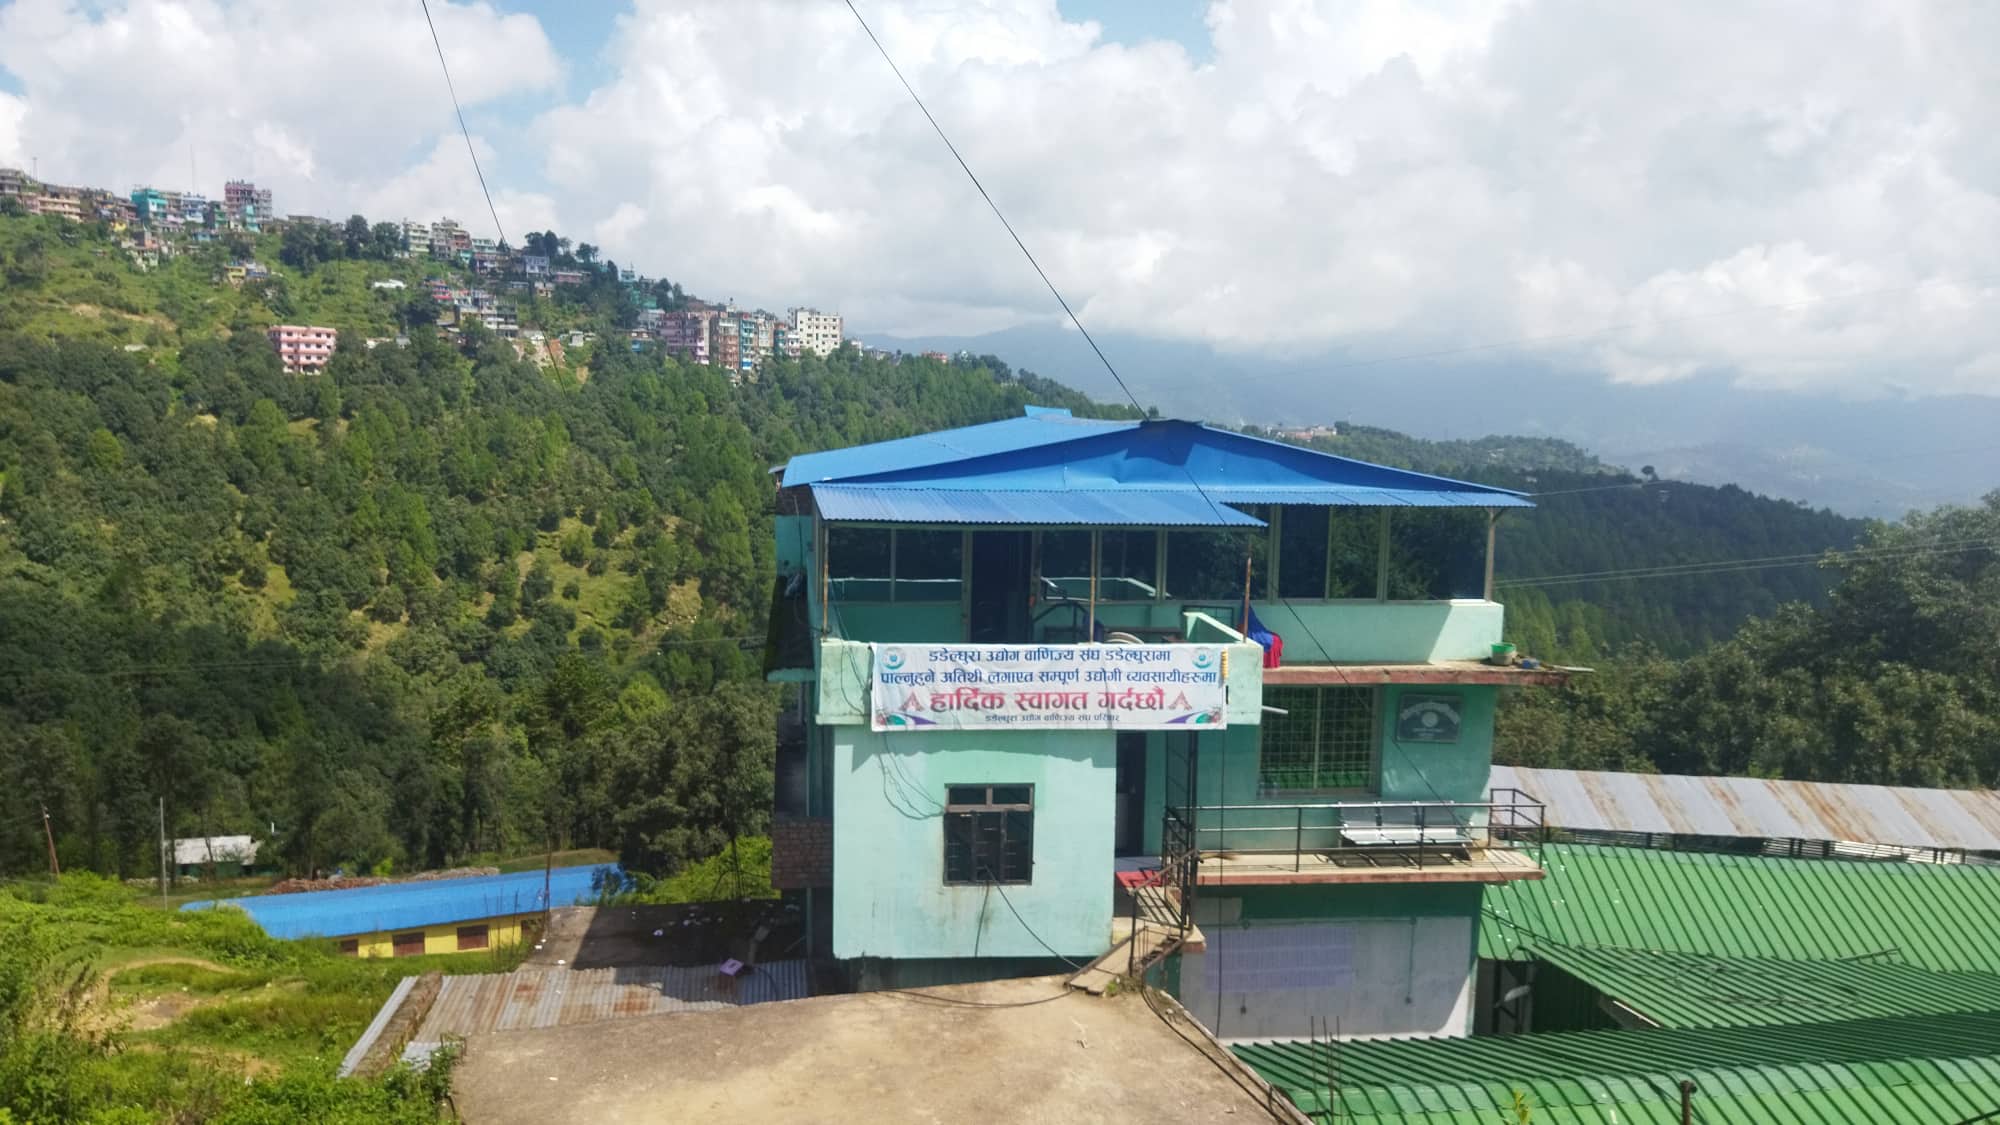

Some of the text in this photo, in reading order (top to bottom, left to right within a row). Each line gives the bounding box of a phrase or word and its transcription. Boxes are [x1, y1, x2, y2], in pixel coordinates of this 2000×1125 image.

[988, 670, 1034, 684] लगाएत
[1038, 667, 1080, 685] सम्पूर्ण
[929, 685, 1006, 712] हार्दिक
[1014, 691, 1089, 711] स्वागत
